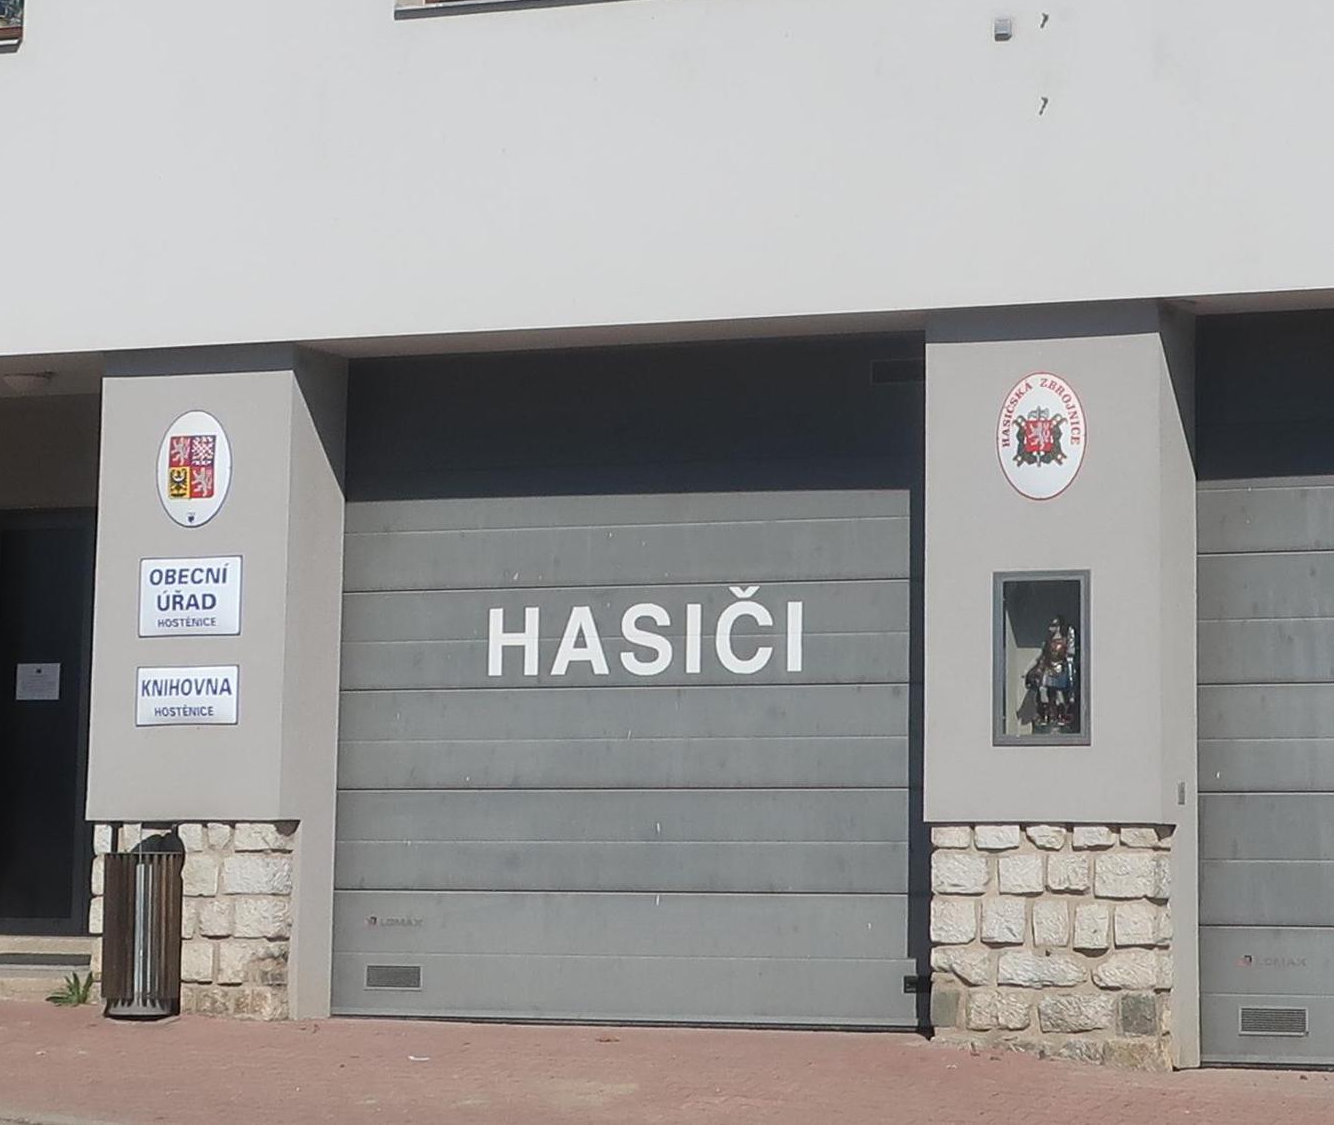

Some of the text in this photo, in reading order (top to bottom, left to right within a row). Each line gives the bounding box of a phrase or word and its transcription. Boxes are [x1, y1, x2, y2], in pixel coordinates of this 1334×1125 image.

[1039, 377, 1081, 445] ZBROJNICE
[149, 563, 229, 586] OBECNÍ
[157, 590, 217, 612] ÚŘAD
[488, 586, 803, 676] HASIČI
[141, 678, 232, 697] KNIHOVNA
